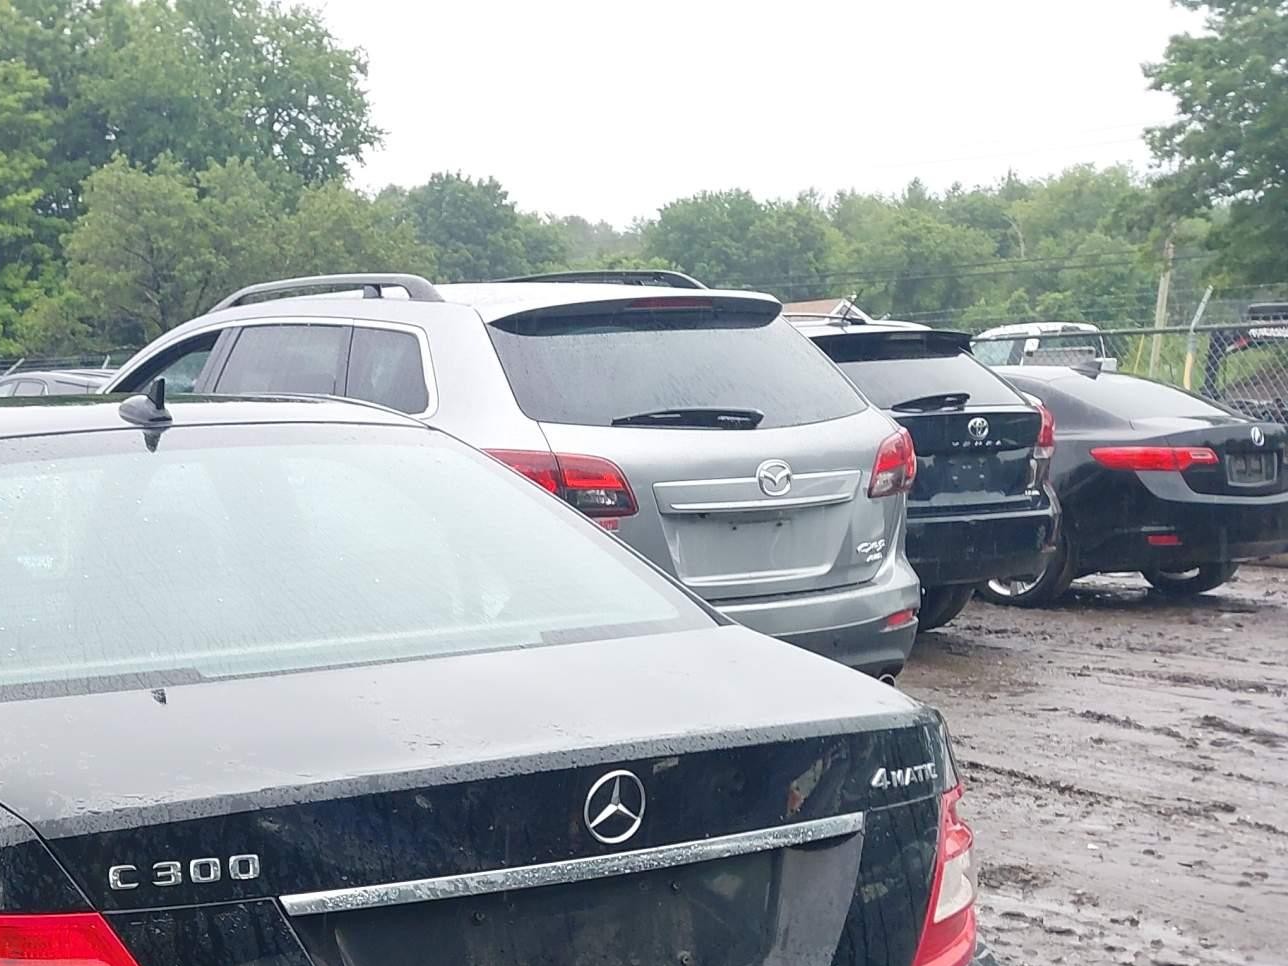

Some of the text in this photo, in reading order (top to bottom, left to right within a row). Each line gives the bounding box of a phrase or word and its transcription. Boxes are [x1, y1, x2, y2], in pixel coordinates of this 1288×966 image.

[871, 762, 938, 790] 4MATIC
[108, 854, 260, 890] C 300
